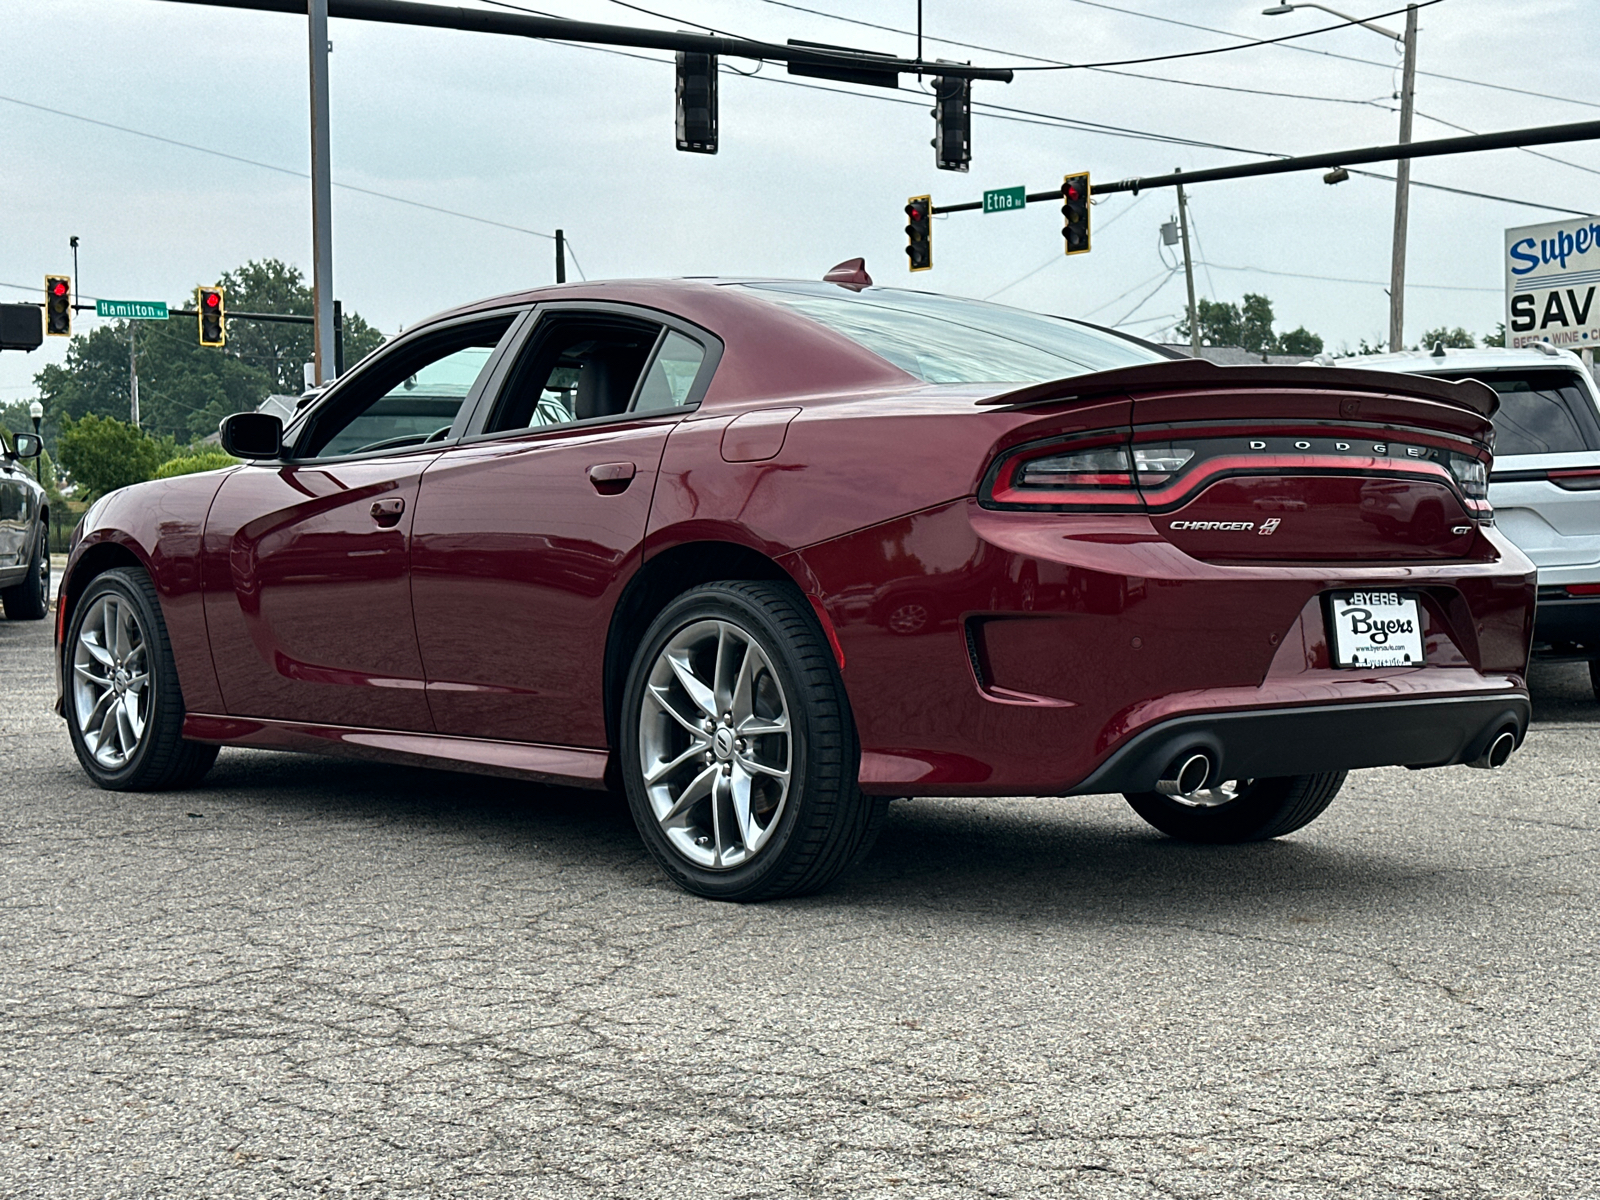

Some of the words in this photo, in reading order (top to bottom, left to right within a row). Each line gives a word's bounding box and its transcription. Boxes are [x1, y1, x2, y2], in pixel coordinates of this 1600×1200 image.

[987, 193, 1012, 210] Etna
[1510, 223, 1600, 275] Super
[101, 302, 155, 317] Hamilton
[1511, 286, 1595, 332] SAV
[1552, 331, 1579, 345] WINE
[1249, 441, 1419, 457] DODGE
[1169, 521, 1255, 531] CHARGER
[1451, 526, 1472, 535] GT
[1353, 592, 1398, 605] BYERS
[1340, 608, 1413, 644] Byers
